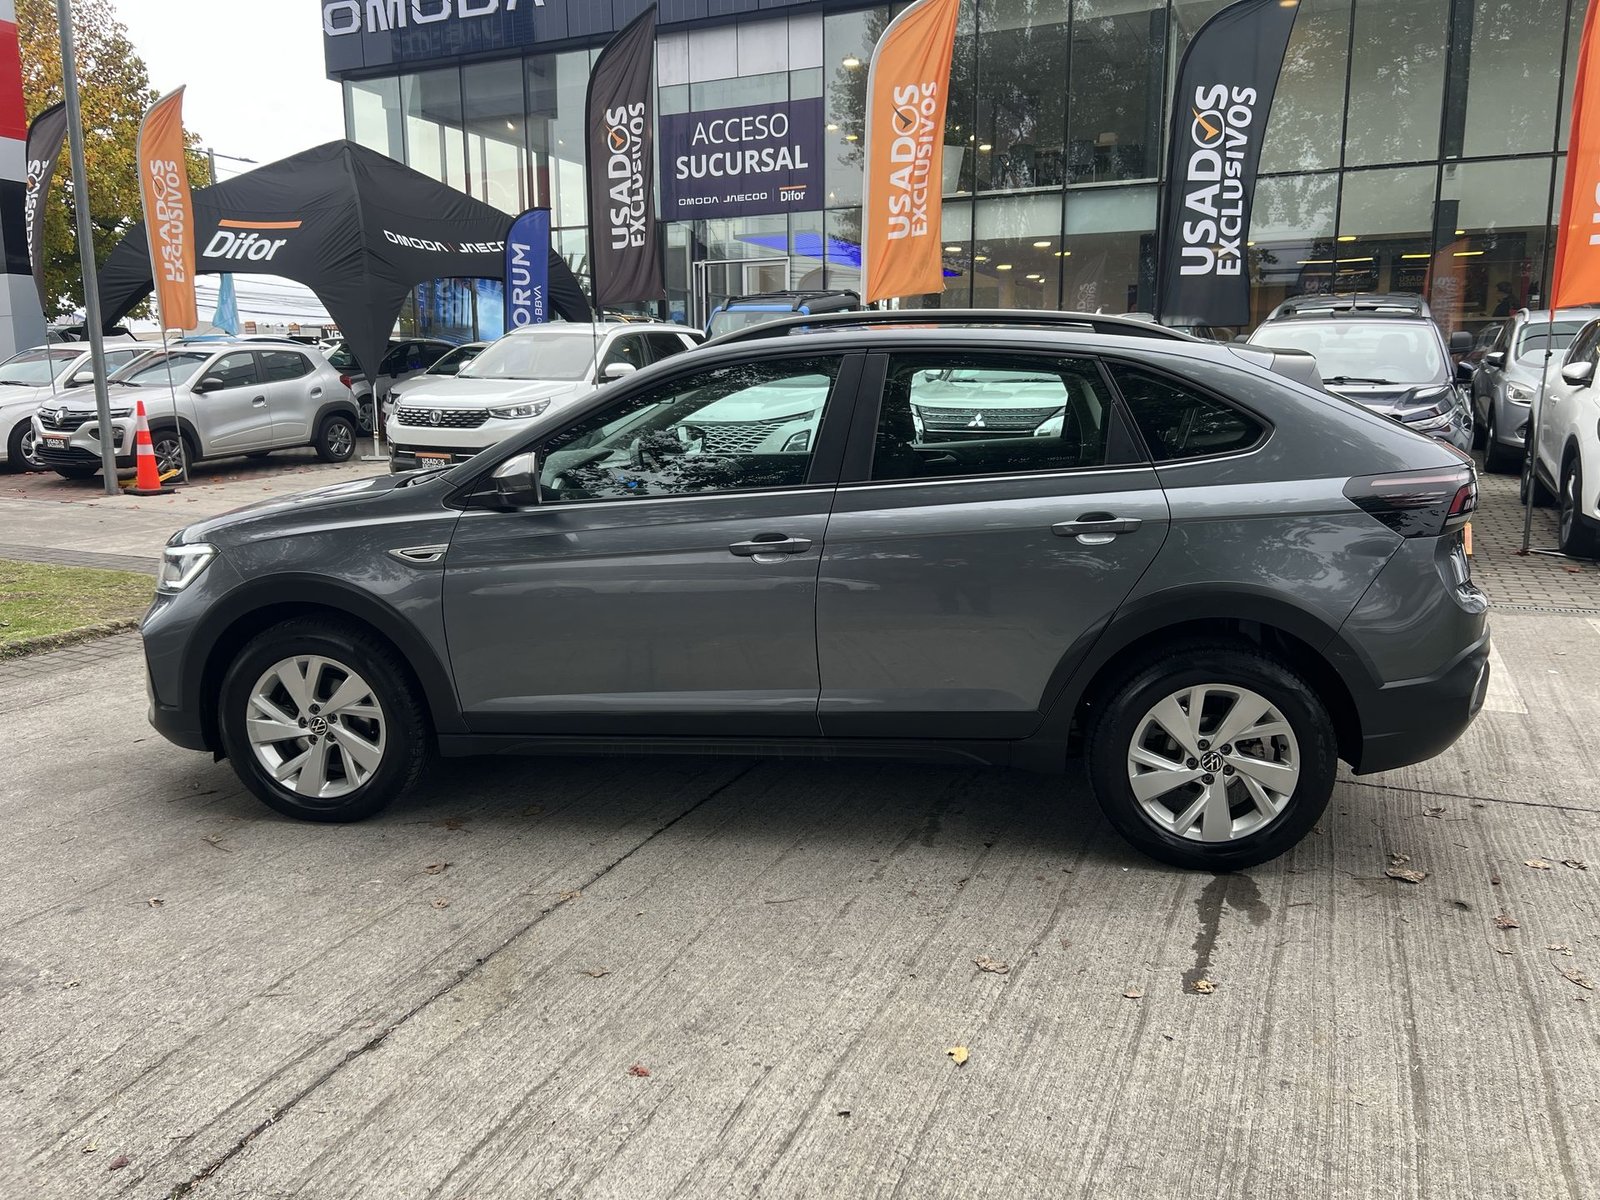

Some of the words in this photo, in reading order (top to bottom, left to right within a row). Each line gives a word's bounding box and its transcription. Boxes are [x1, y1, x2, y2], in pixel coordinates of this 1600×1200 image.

[323, 0, 545, 37] OMOD
[606, 105, 631, 250] USADOS
[628, 102, 646, 248] EXCLUSIVOS
[676, 145, 809, 180] SUCURSAL
[692, 113, 789, 146] ACCESO
[888, 84, 920, 240] USADOS
[911, 81, 937, 238] EXCLUSIVOS
[1180, 83, 1229, 276] USADOS
[1216, 85, 1257, 276] EXCLUSIVOS
[150, 159, 175, 281] USADOS
[164, 160, 185, 283] EXCLUSIVOS
[202, 230, 287, 261] Difor
[383, 229, 449, 253] OMODA
[678, 196, 719, 206] OMODA
[723, 192, 768, 203] JAECOO
[780, 190, 806, 202] Difor
[511, 243, 531, 329] ORUM
[534, 285, 543, 316] BBVA
